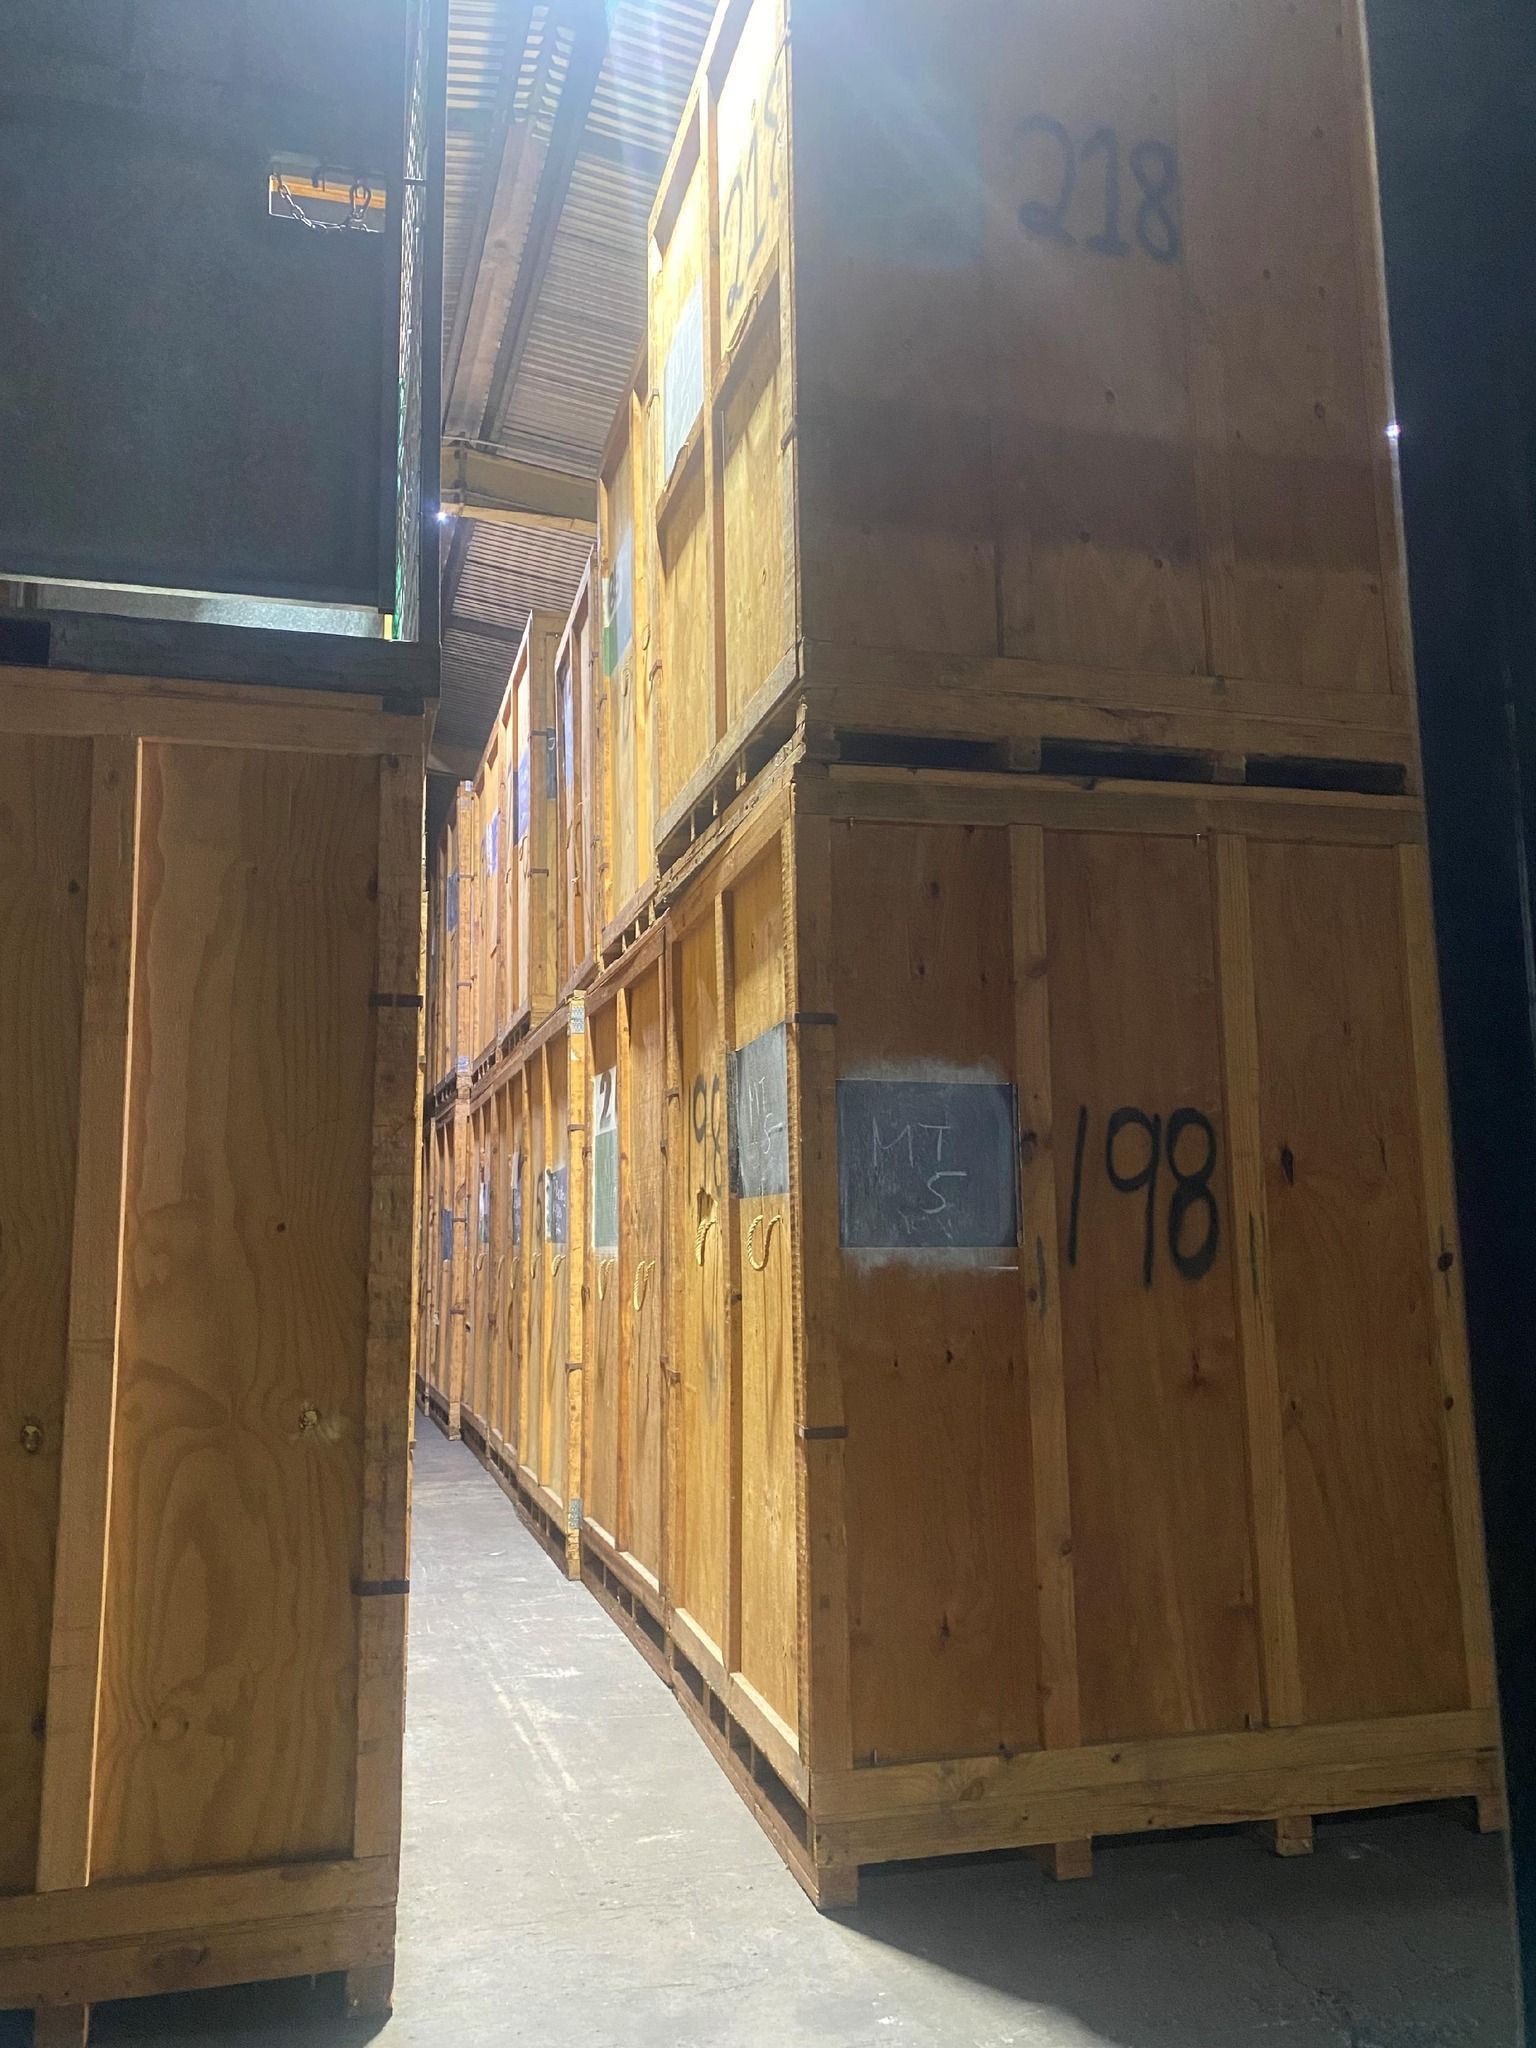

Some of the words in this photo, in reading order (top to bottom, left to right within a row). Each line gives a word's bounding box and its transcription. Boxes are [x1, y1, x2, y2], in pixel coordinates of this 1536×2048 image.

[1014, 115, 1179, 265] 218
[872, 1116, 951, 1169] MT
[921, 1170, 968, 1214] 5
[1068, 1105, 1220, 1289] 198
